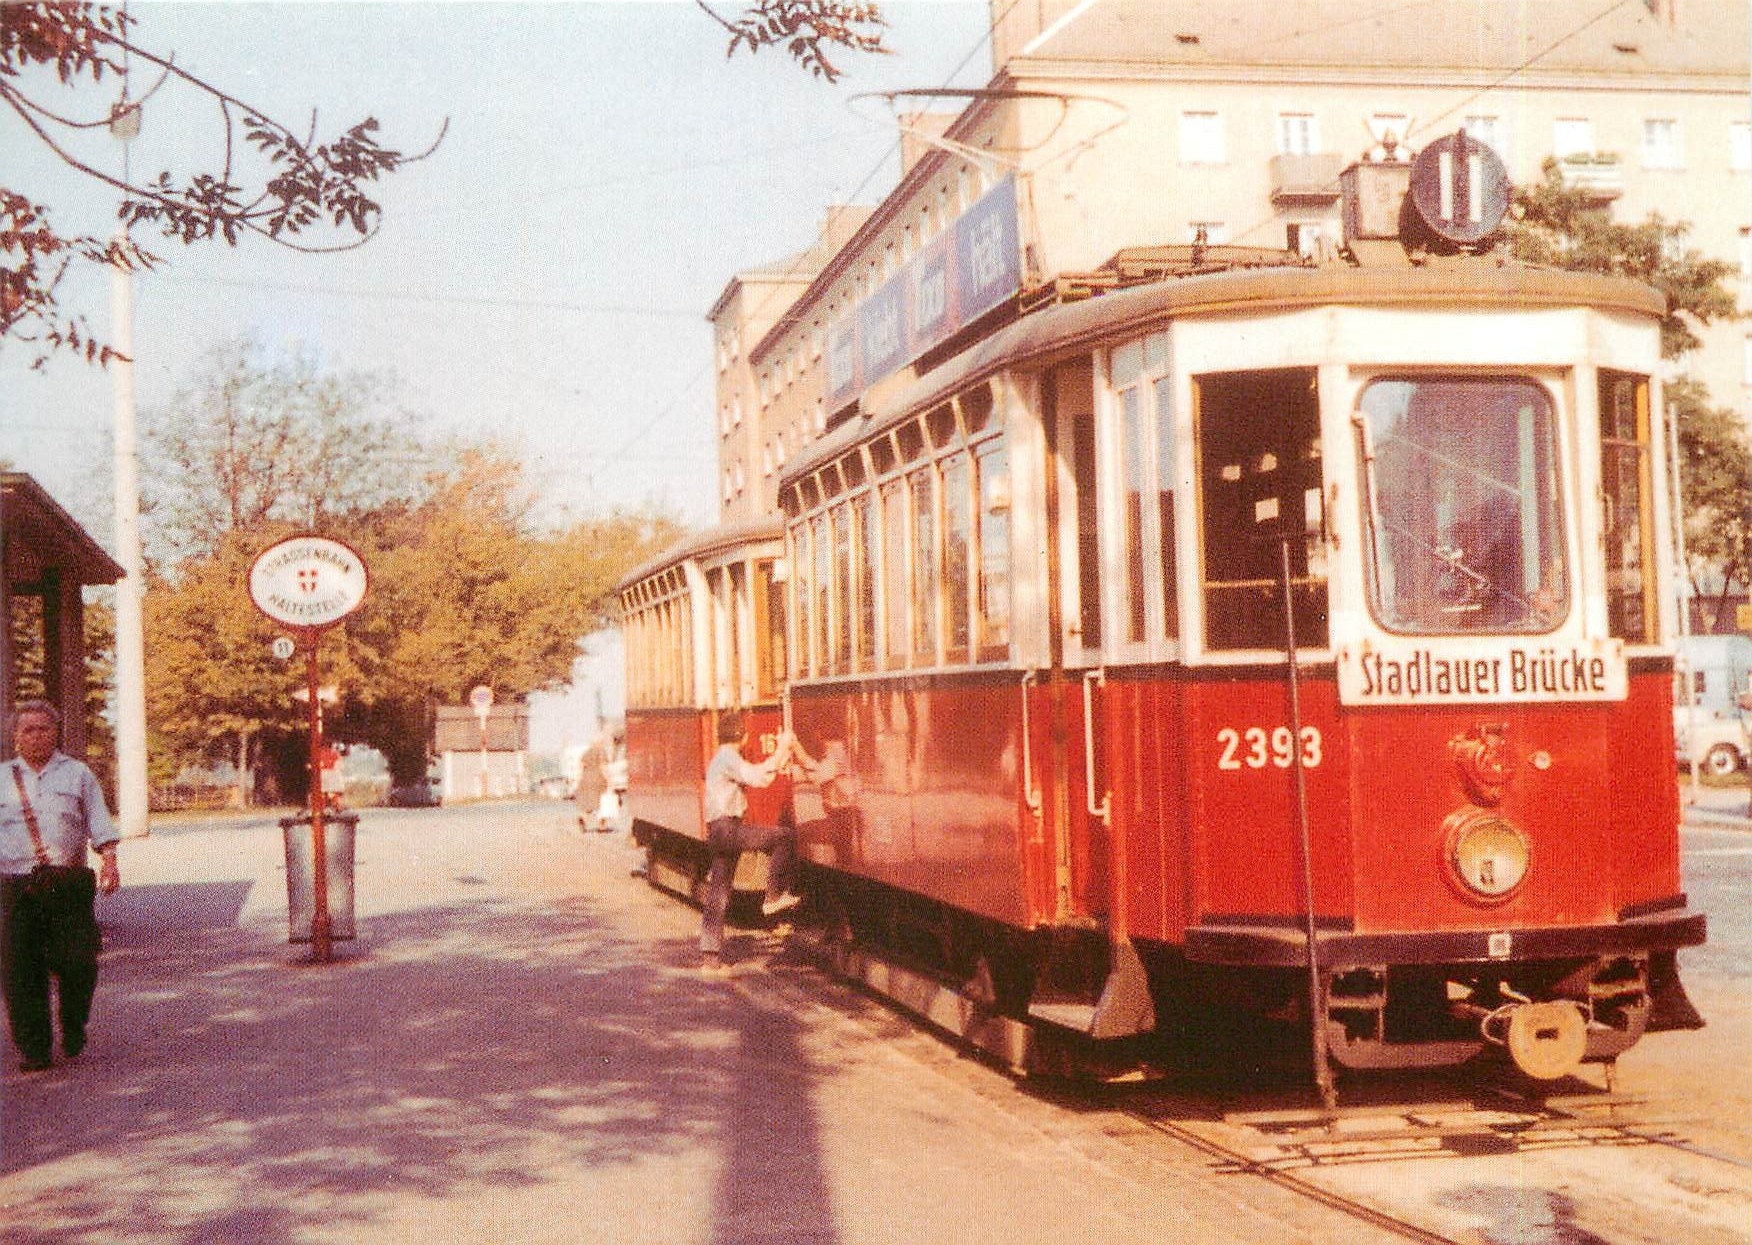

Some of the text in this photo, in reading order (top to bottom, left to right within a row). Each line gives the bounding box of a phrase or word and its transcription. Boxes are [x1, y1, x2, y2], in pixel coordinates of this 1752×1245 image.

[1361, 649, 1605, 697] Stadlauer Brücke
[1216, 726, 1323, 771] 2393
